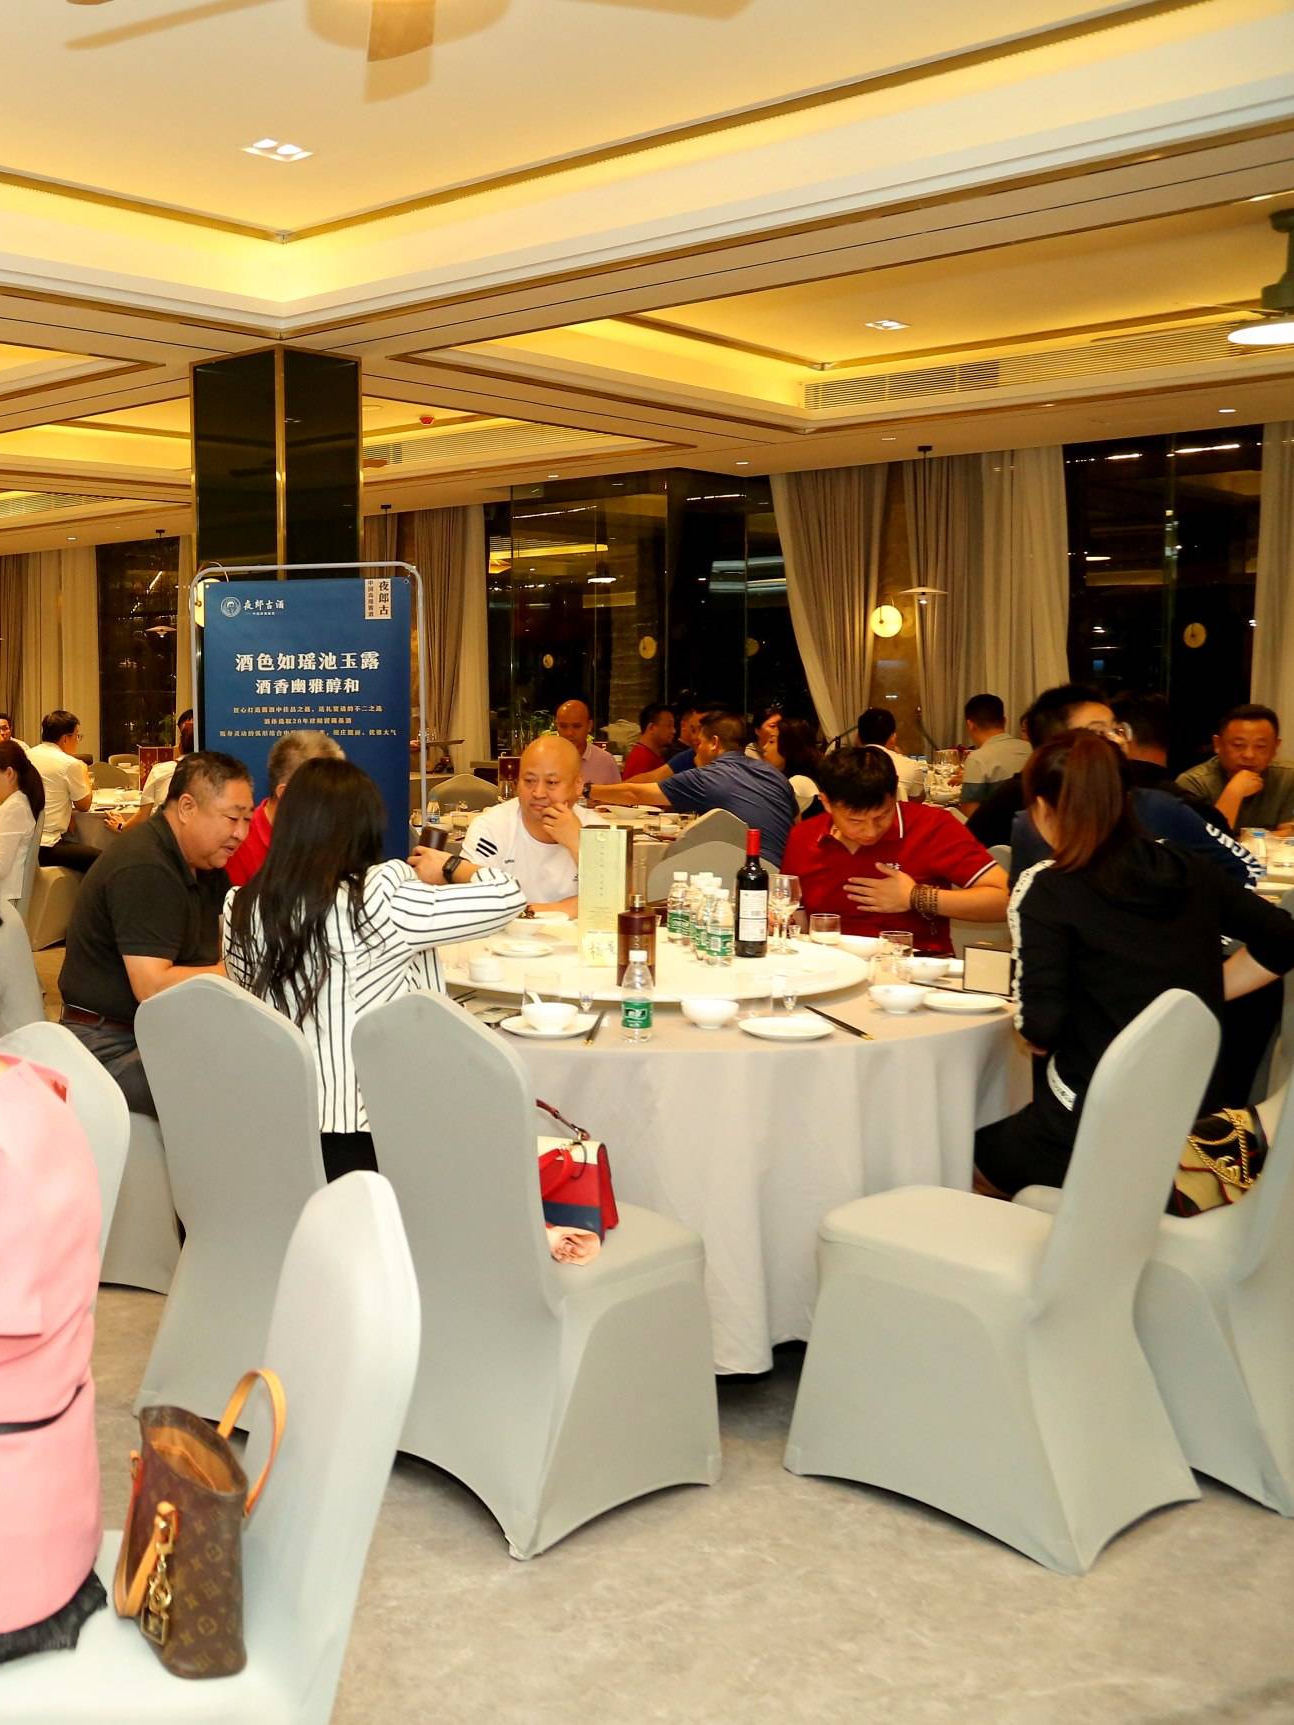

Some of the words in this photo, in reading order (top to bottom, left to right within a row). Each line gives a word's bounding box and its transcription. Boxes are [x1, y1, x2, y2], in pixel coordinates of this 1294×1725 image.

[243, 599, 285, 611] 夜郎古酒
[378, 580, 390, 616] 夜郎古
[235, 651, 380, 672] 酒色如瑶池玉露
[256, 678, 360, 695] 酒香幽雅醇和
